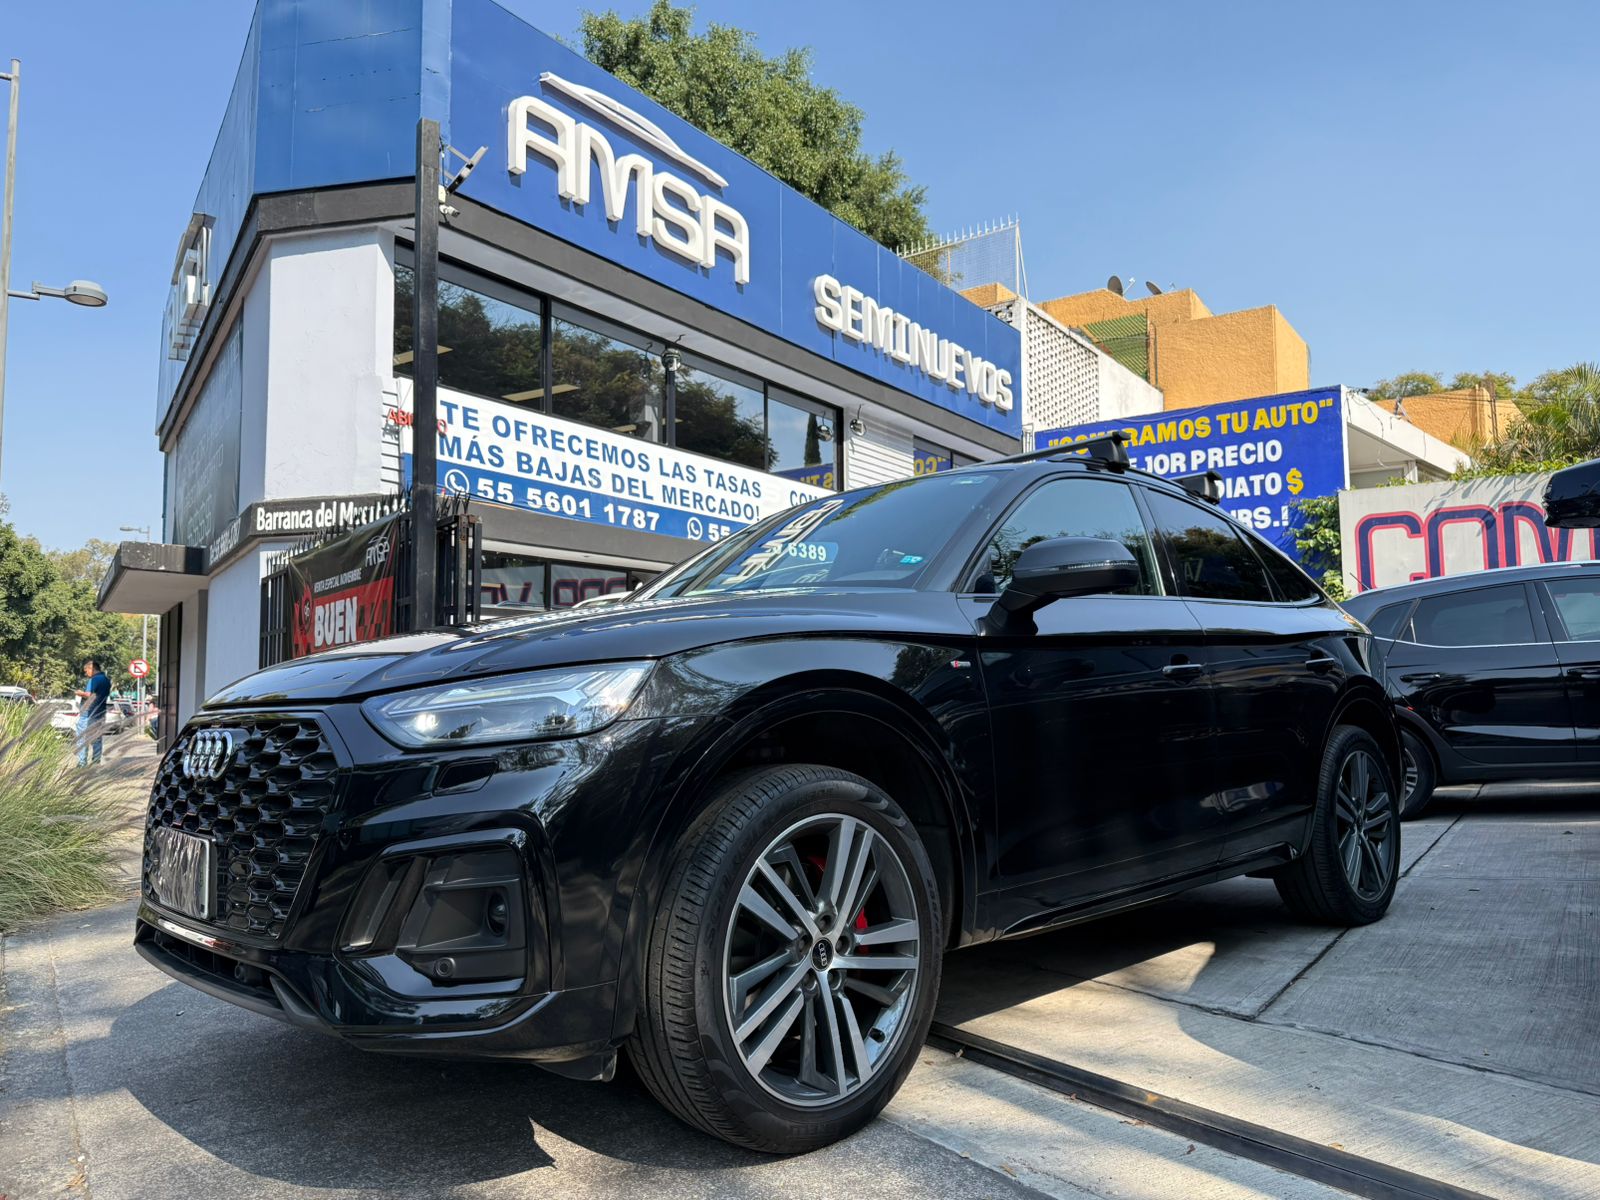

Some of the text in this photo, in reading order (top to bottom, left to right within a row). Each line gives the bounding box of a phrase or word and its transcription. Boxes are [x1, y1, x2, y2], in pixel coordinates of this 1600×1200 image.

[508, 95, 750, 285] AMSA
[814, 274, 1013, 411] SEMINUEVOS
[1216, 411, 1249, 435] TU
[440, 400, 762, 498] TE OFRECEMOS LAS TASAS
[1191, 440, 1283, 471] PRECIO
[439, 434, 504, 468] MÁS
[517, 451, 602, 488] BAJAS
[611, 473, 654, 500] DEL
[662, 485, 760, 521] MERCADO!
[1286, 467, 1304, 495] $
[257, 506, 313, 531] Barranca
[316, 501, 337, 527] del
[477, 478, 660, 530] 55 5601 1787
[314, 596, 358, 647] BUEN
